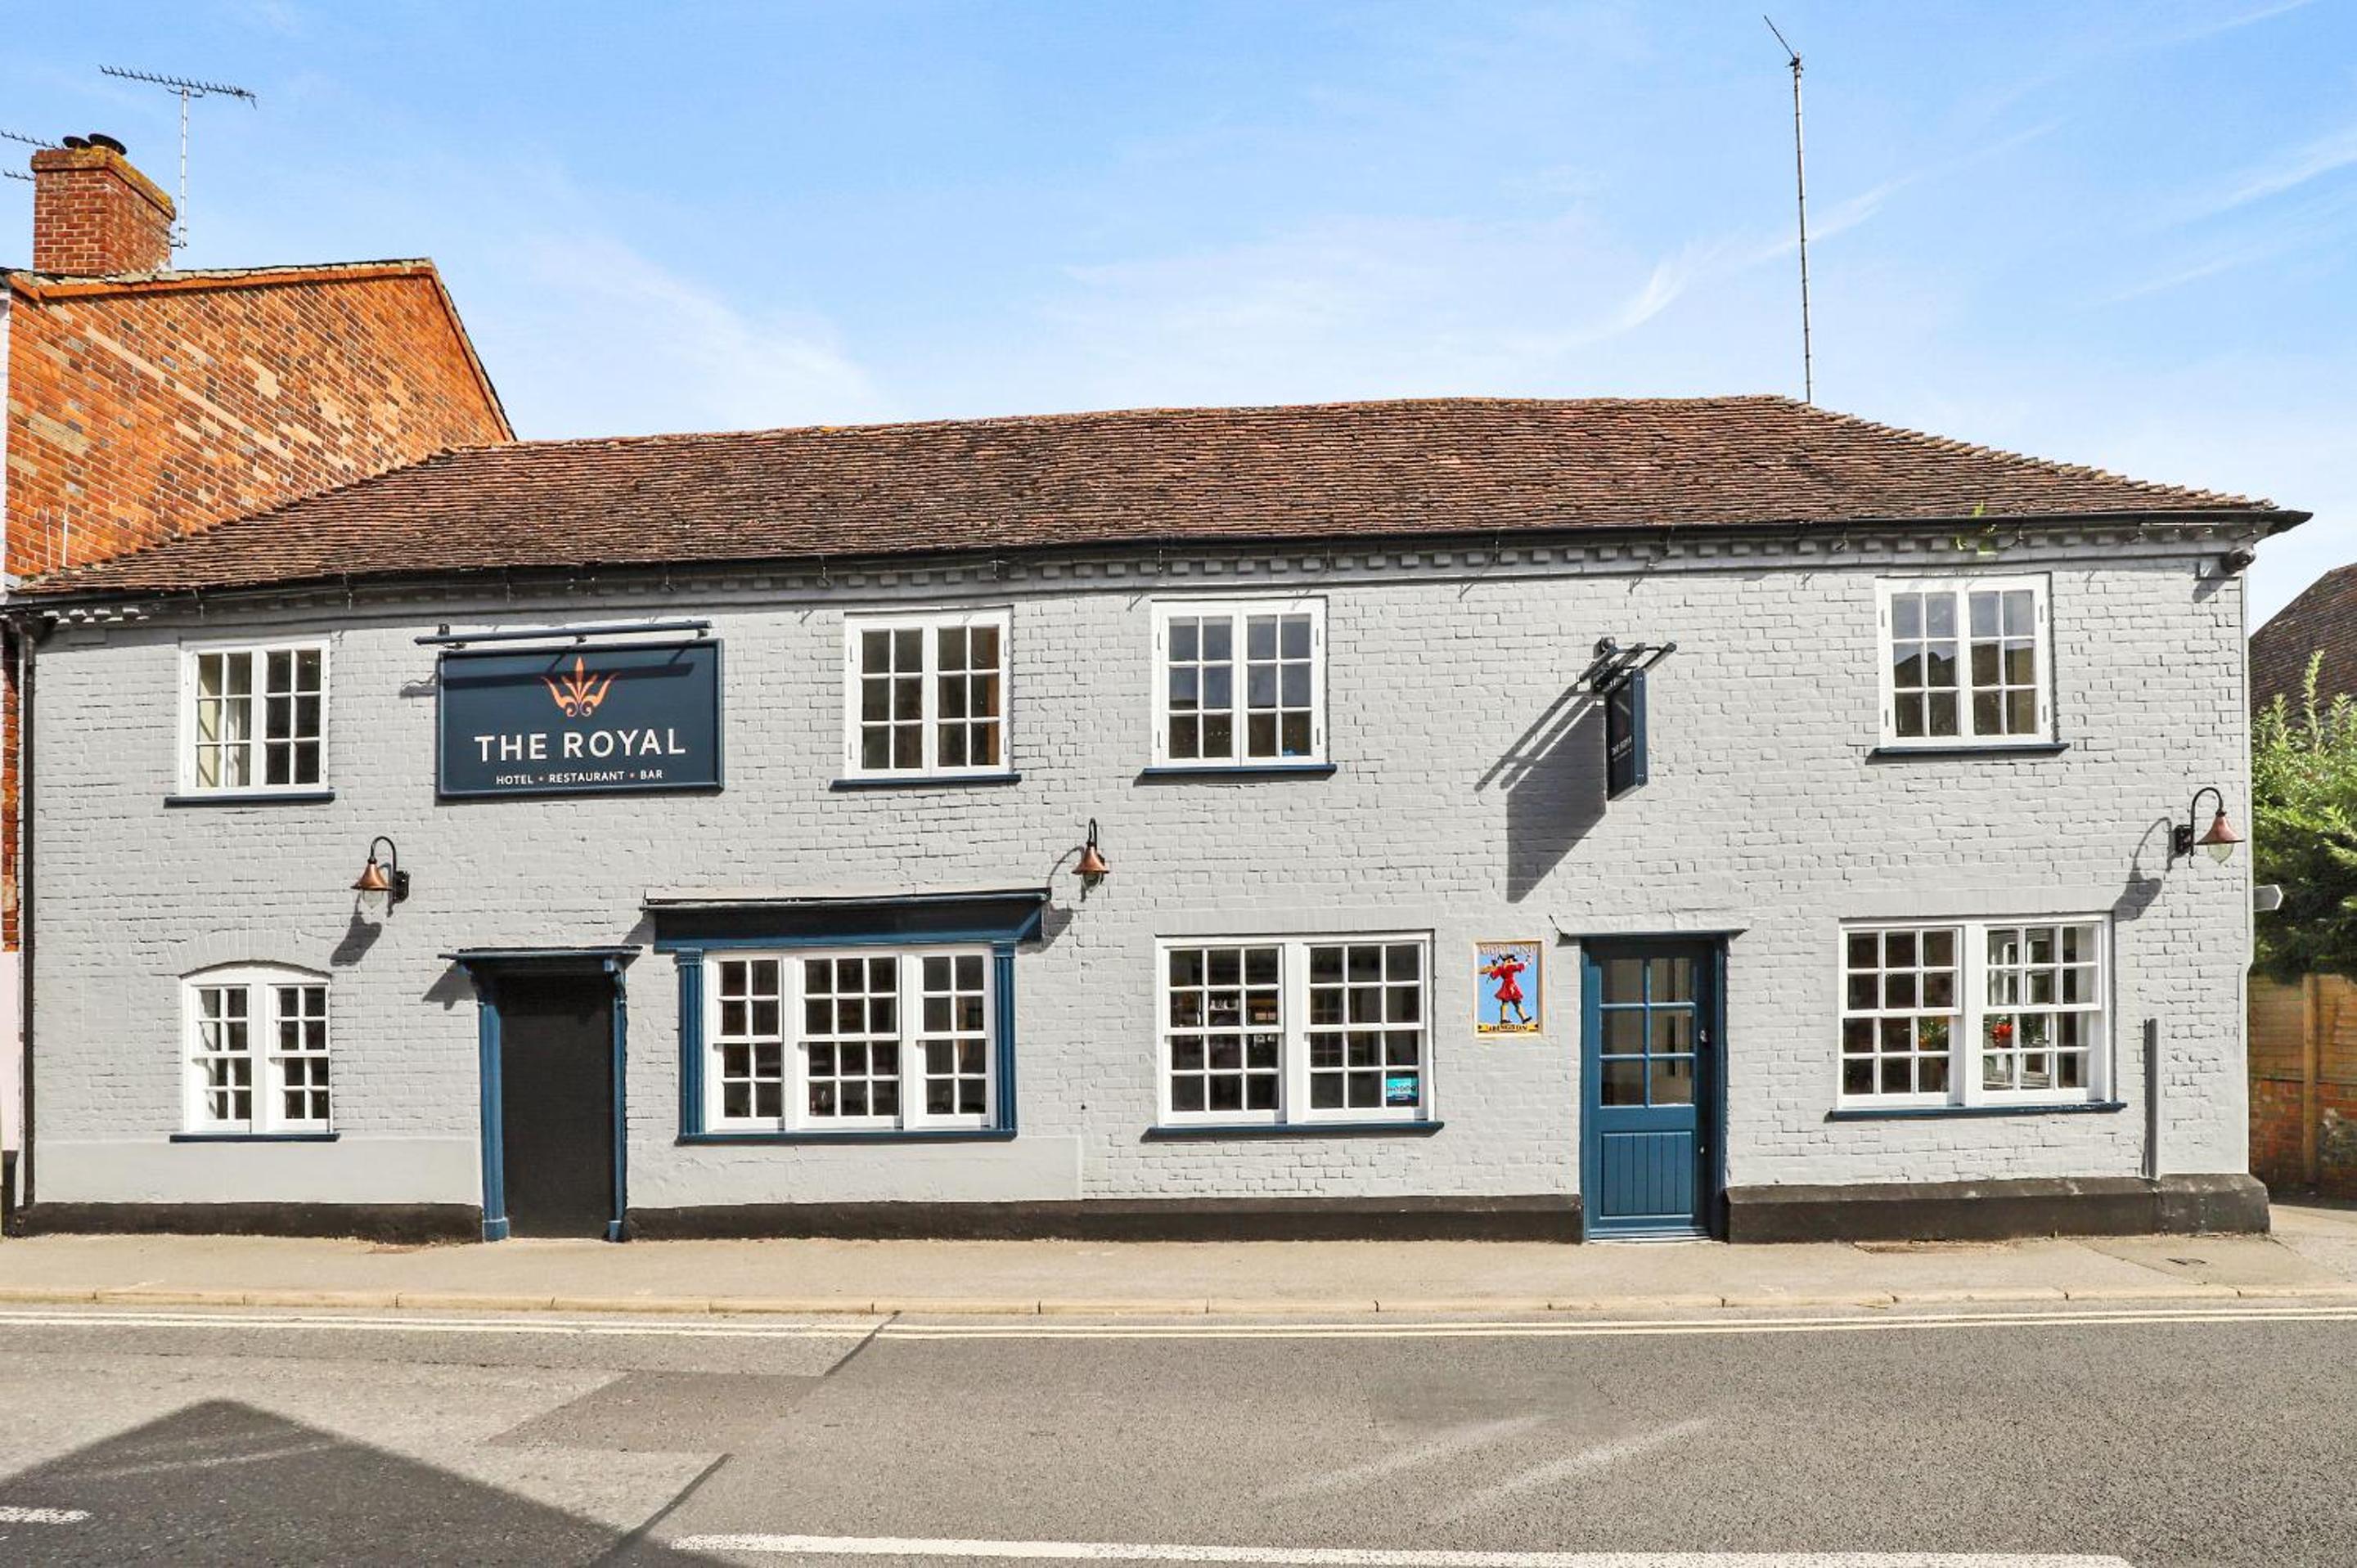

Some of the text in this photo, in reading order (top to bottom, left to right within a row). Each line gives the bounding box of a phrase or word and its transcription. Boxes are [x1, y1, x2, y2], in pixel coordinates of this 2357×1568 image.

[474, 728, 686, 763] THE ROYAL
[495, 769, 663, 785] HOTEL RESTAURANT BAR
